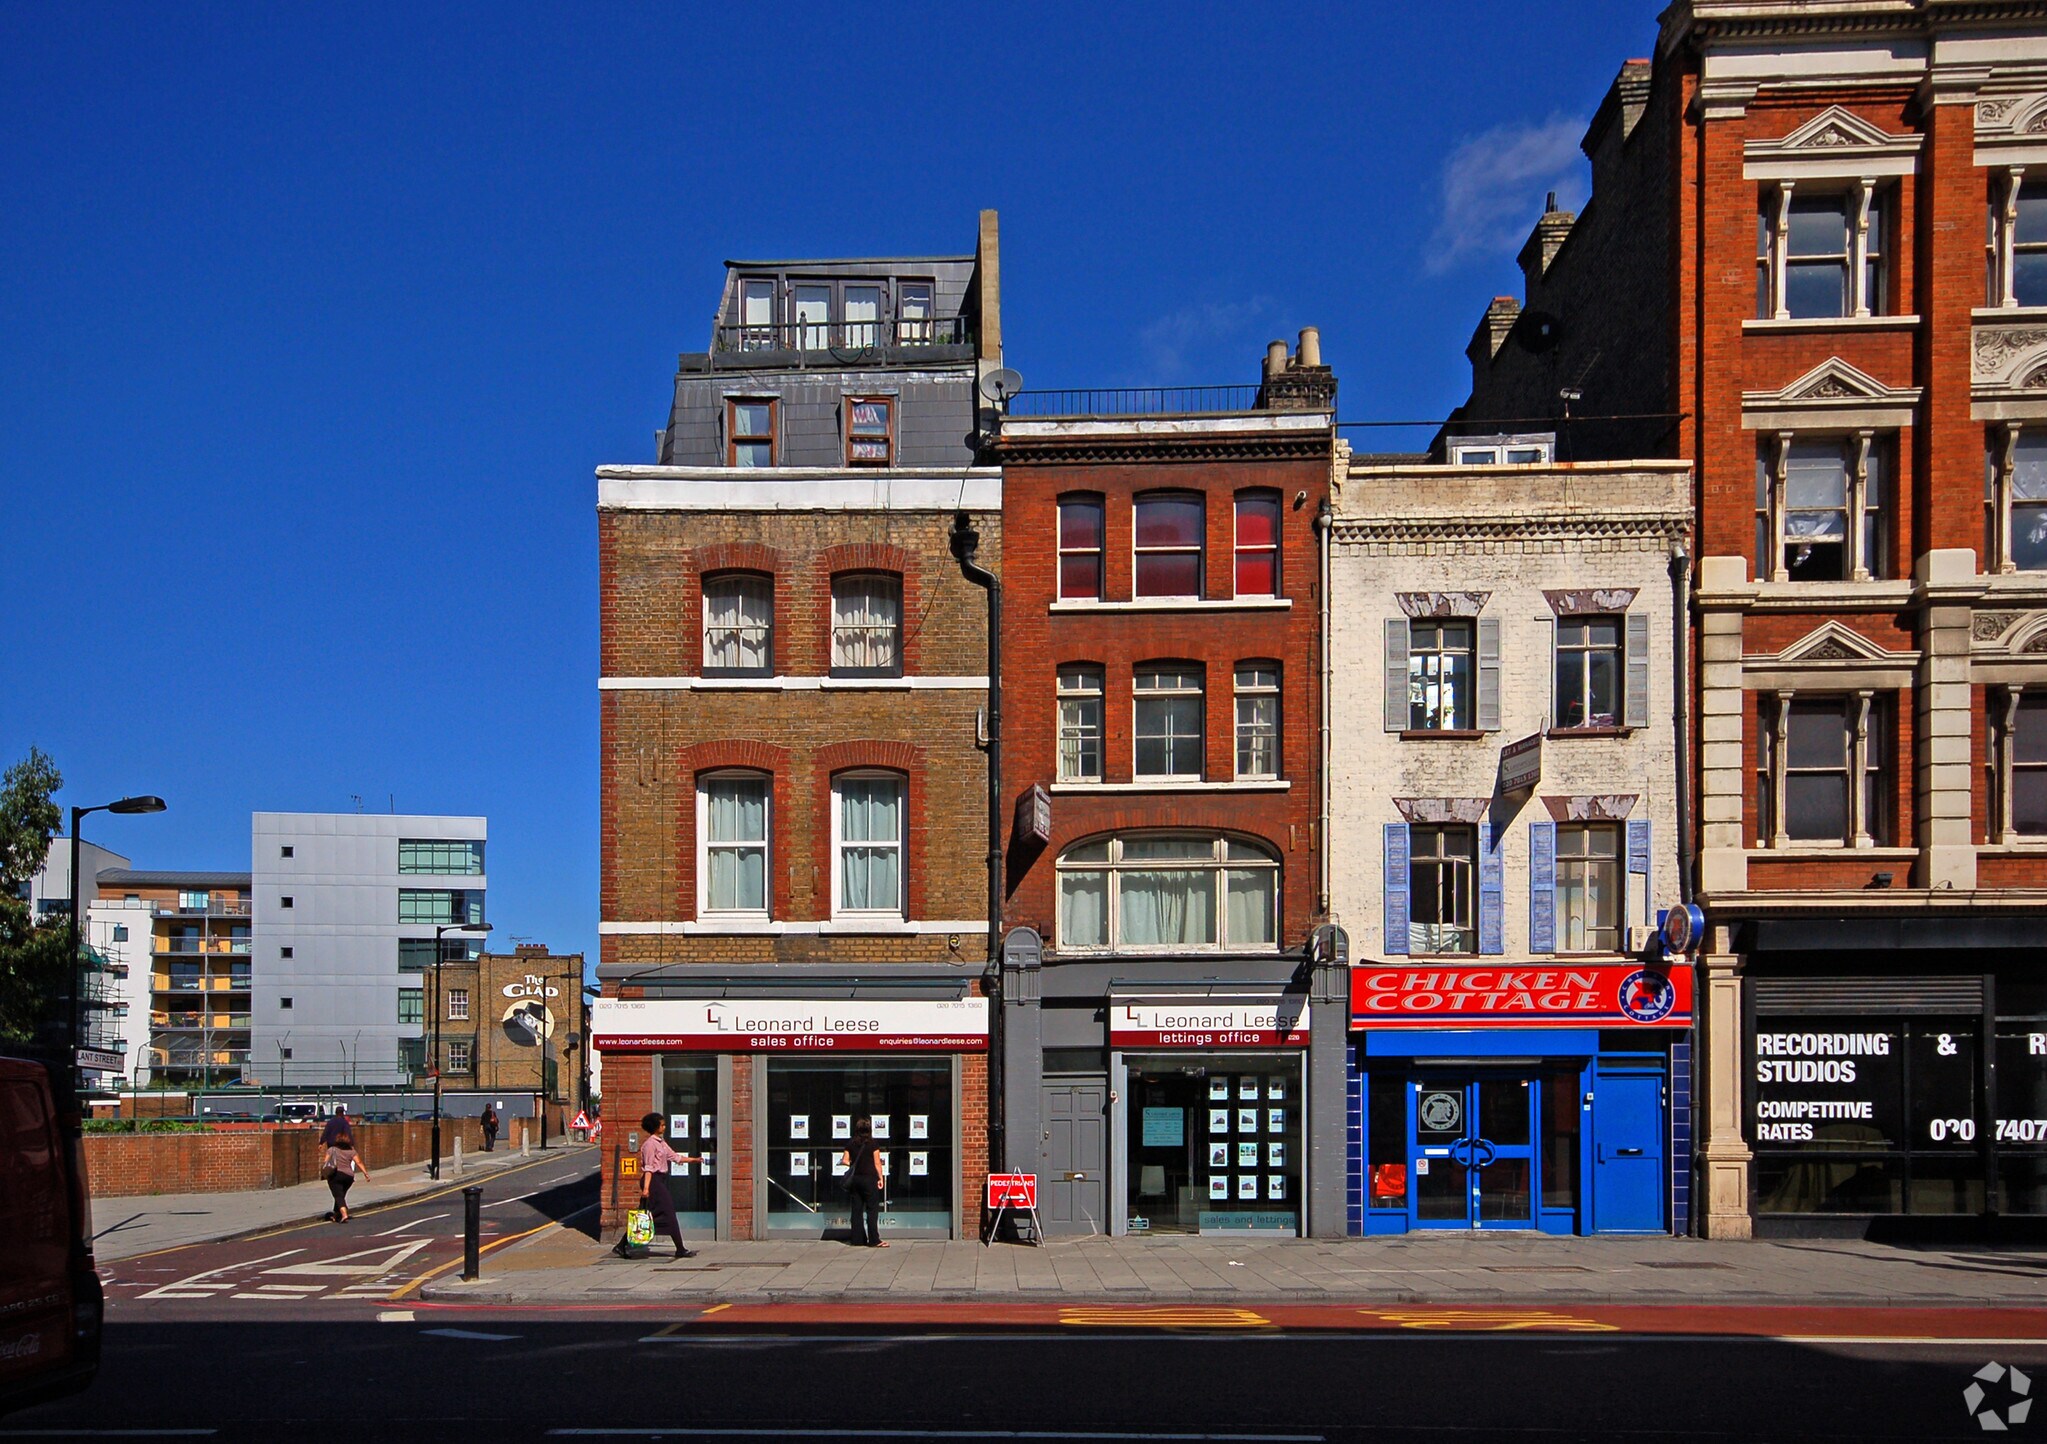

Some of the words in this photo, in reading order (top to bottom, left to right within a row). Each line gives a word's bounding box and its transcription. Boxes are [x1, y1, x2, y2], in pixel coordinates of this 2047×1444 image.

[524, 974, 544, 985] The
[1366, 972, 1599, 991] CHICKEN
[502, 983, 559, 998] GLAD
[1366, 992, 1600, 1010] COTTAGE
[735, 1016, 813, 1031] Leonard
[824, 1016, 879, 1031] Leese
[1155, 1012, 1233, 1028] Leonard
[1244, 1012, 1300, 1028] Leese
[598, 1037, 683, 1046] www.leonardleese.com
[750, 1035, 787, 1047] sales
[793, 1035, 834, 1047] office
[879, 1037, 983, 1047] enquiries@leonardleese.com
[1159, 1032, 1212, 1045] lettings
[1219, 1032, 1260, 1043] office
[1757, 1033, 1889, 1055] RECORDING
[1936, 1033, 1958, 1055] &
[2029, 1033, 2047, 1055] R
[94, 1053, 118, 1064] STREET
[1757, 1060, 1856, 1082] STUDIOS
[1757, 1101, 1873, 1119] COMPETITIVE
[1757, 1123, 1813, 1140] RATES
[1995, 1119, 2047, 1141] 7407
[623, 1155, 635, 1173] H
[1204, 1215, 1230, 1224] sales
[1234, 1215, 1253, 1224] and
[1256, 1215, 1295, 1226] lettings
